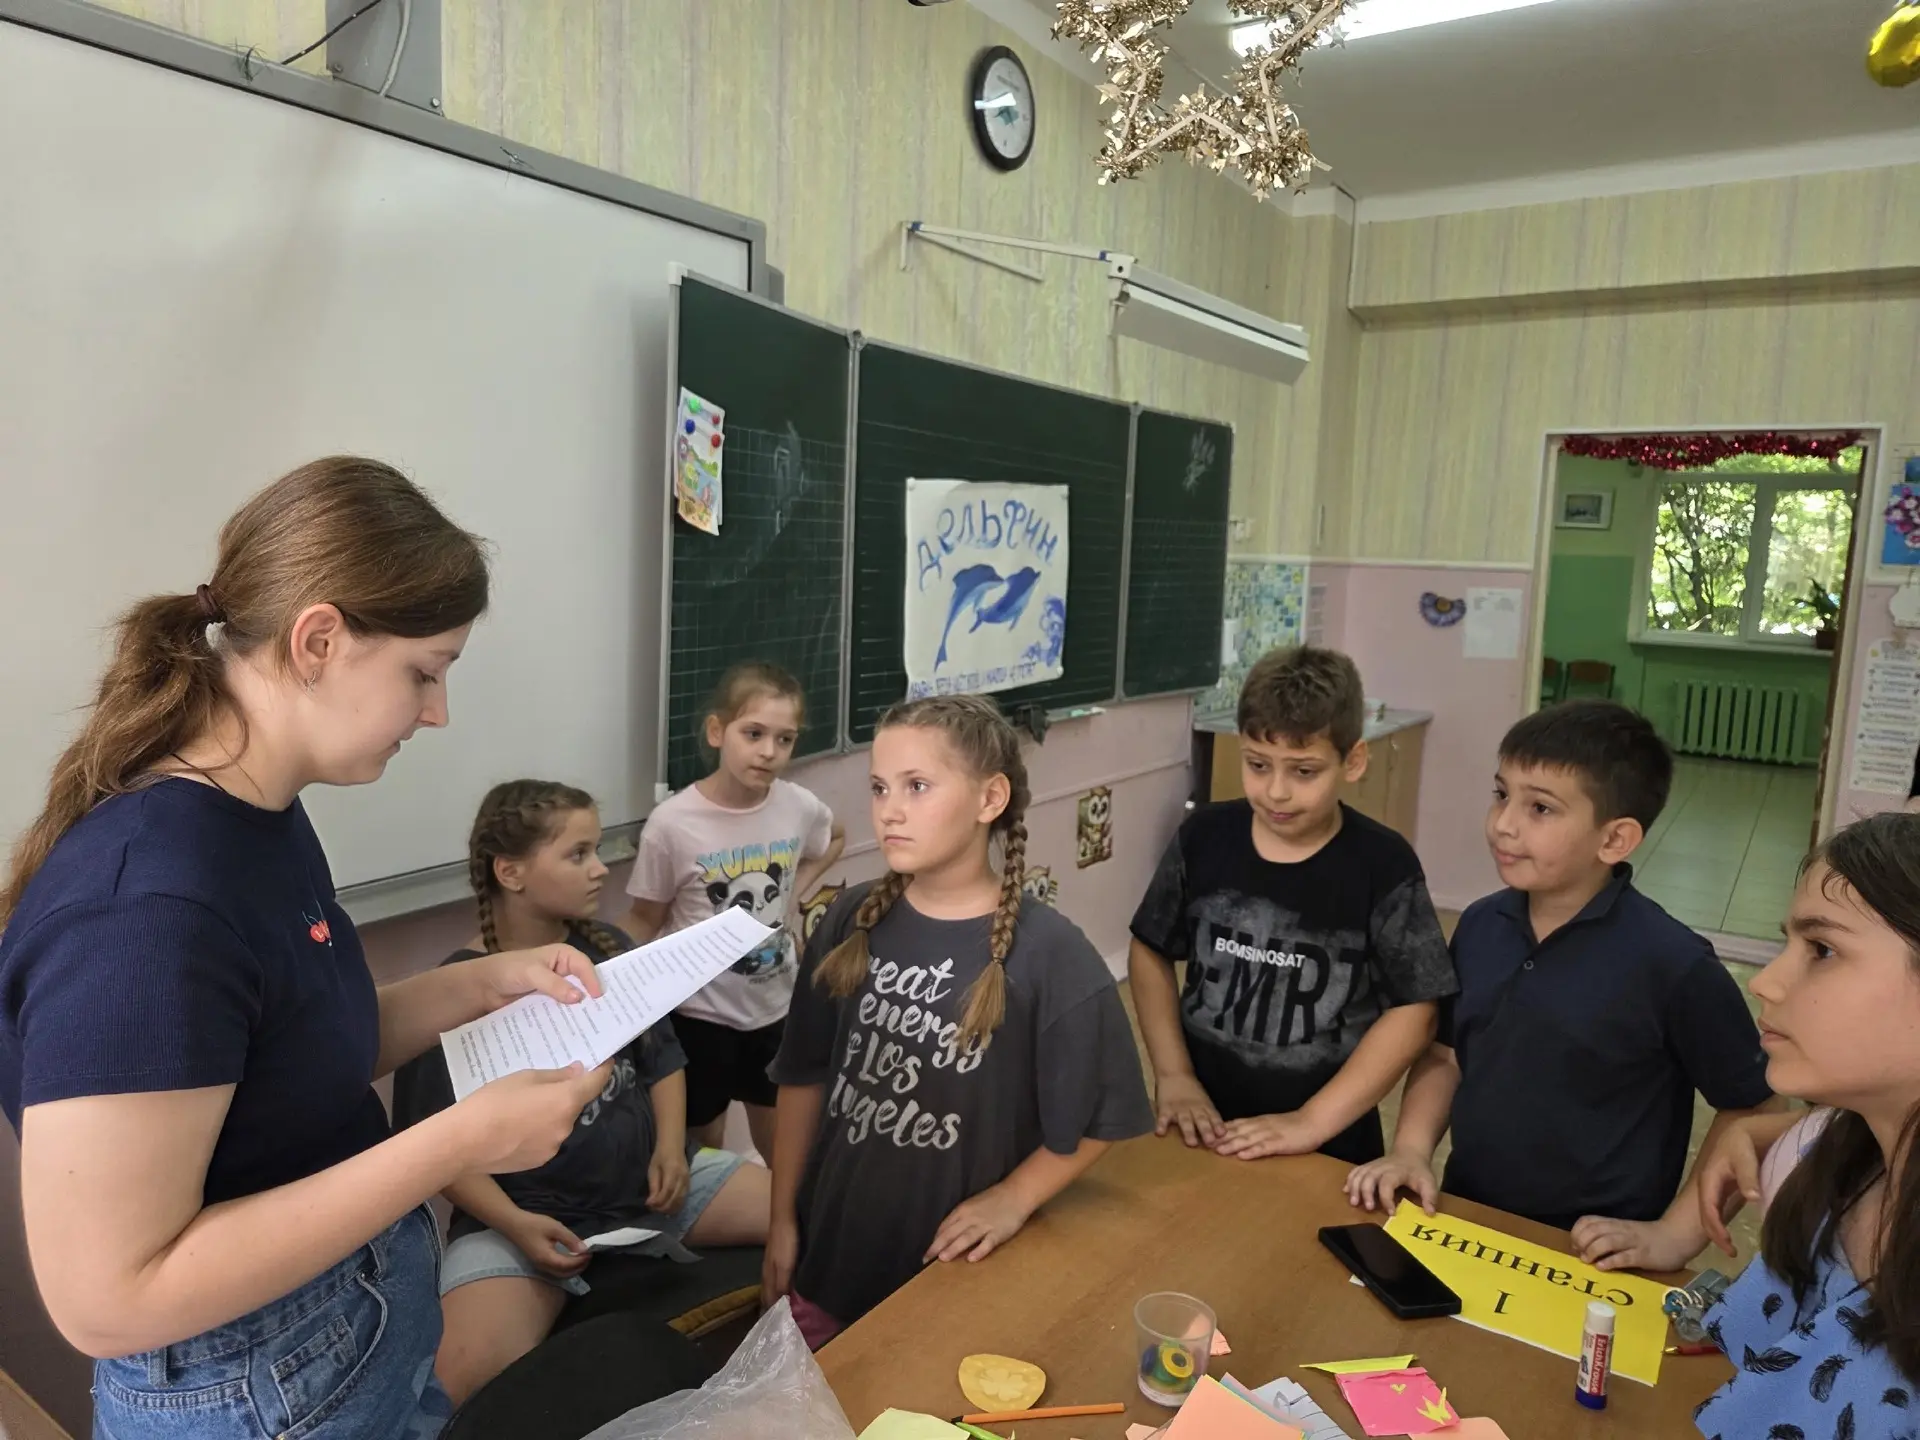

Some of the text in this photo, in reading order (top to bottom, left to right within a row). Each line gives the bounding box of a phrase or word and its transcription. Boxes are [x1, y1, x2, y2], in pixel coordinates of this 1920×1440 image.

[1214, 936, 1306, 968] BOMSINOSAT
[869, 955, 954, 1004] reat
[1493, 1288, 1515, 1315] 1
